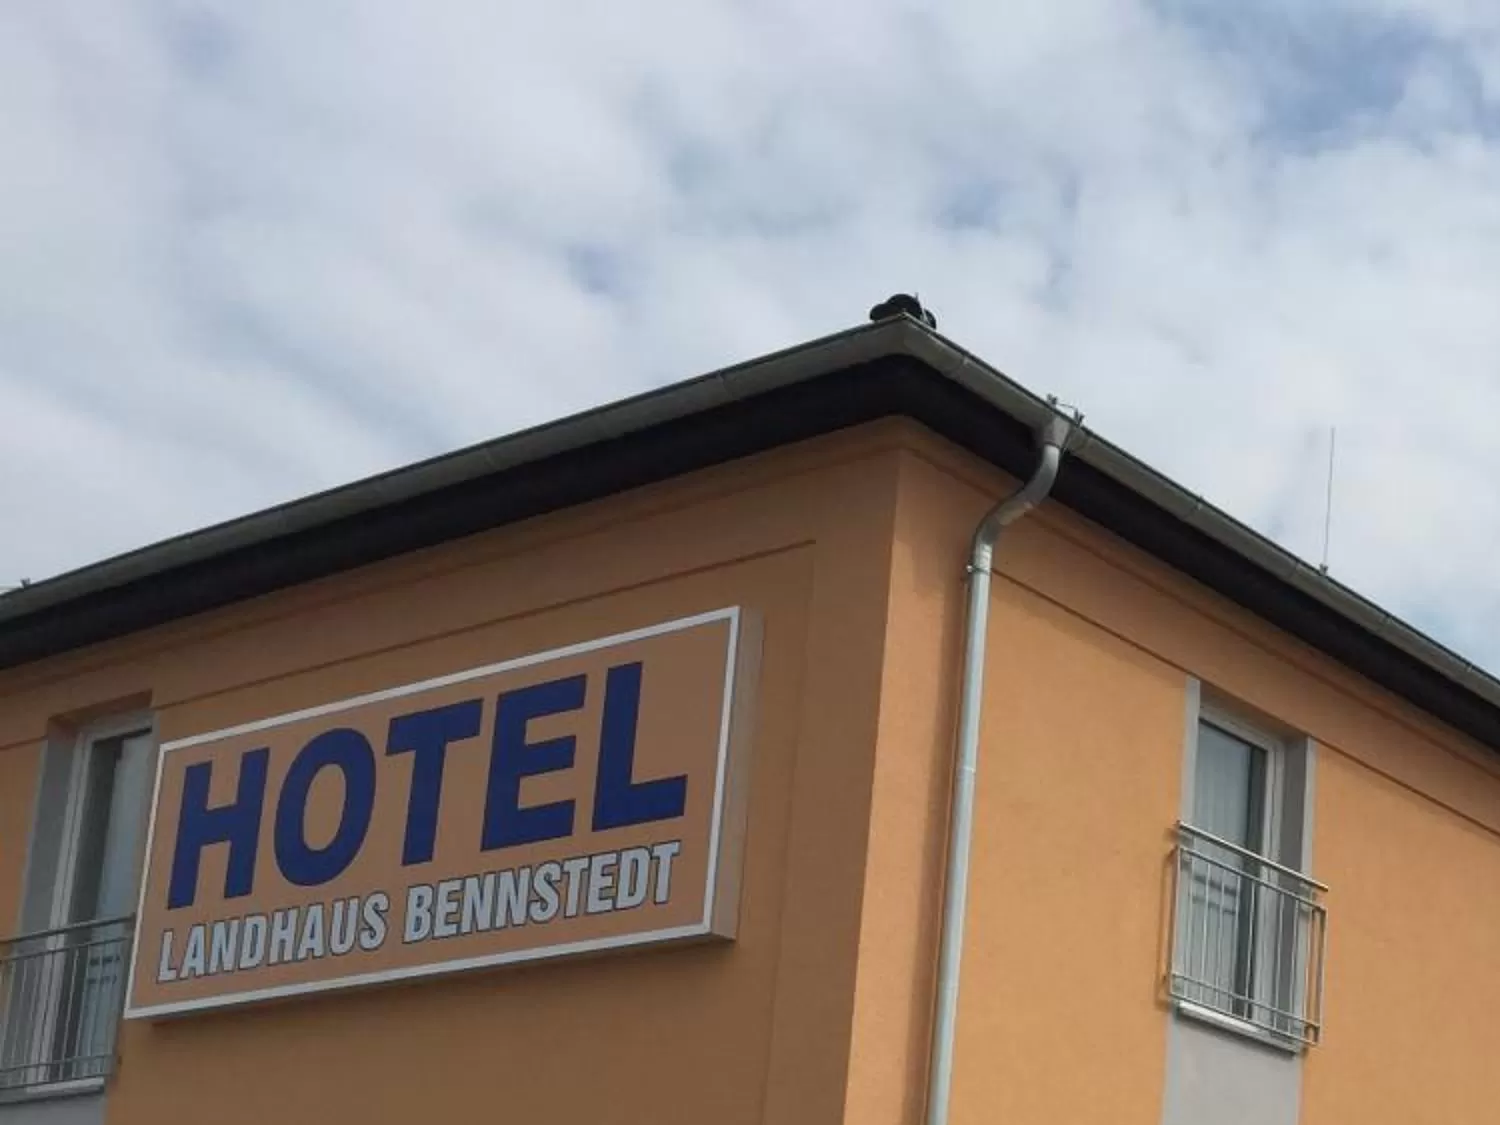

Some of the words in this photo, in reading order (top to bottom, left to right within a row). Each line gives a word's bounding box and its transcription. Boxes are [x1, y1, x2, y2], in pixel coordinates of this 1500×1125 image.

[168, 661, 688, 909] HOTEL
[157, 892, 388, 983] LANDHAUS
[402, 841, 681, 944] BENNSTEDT
